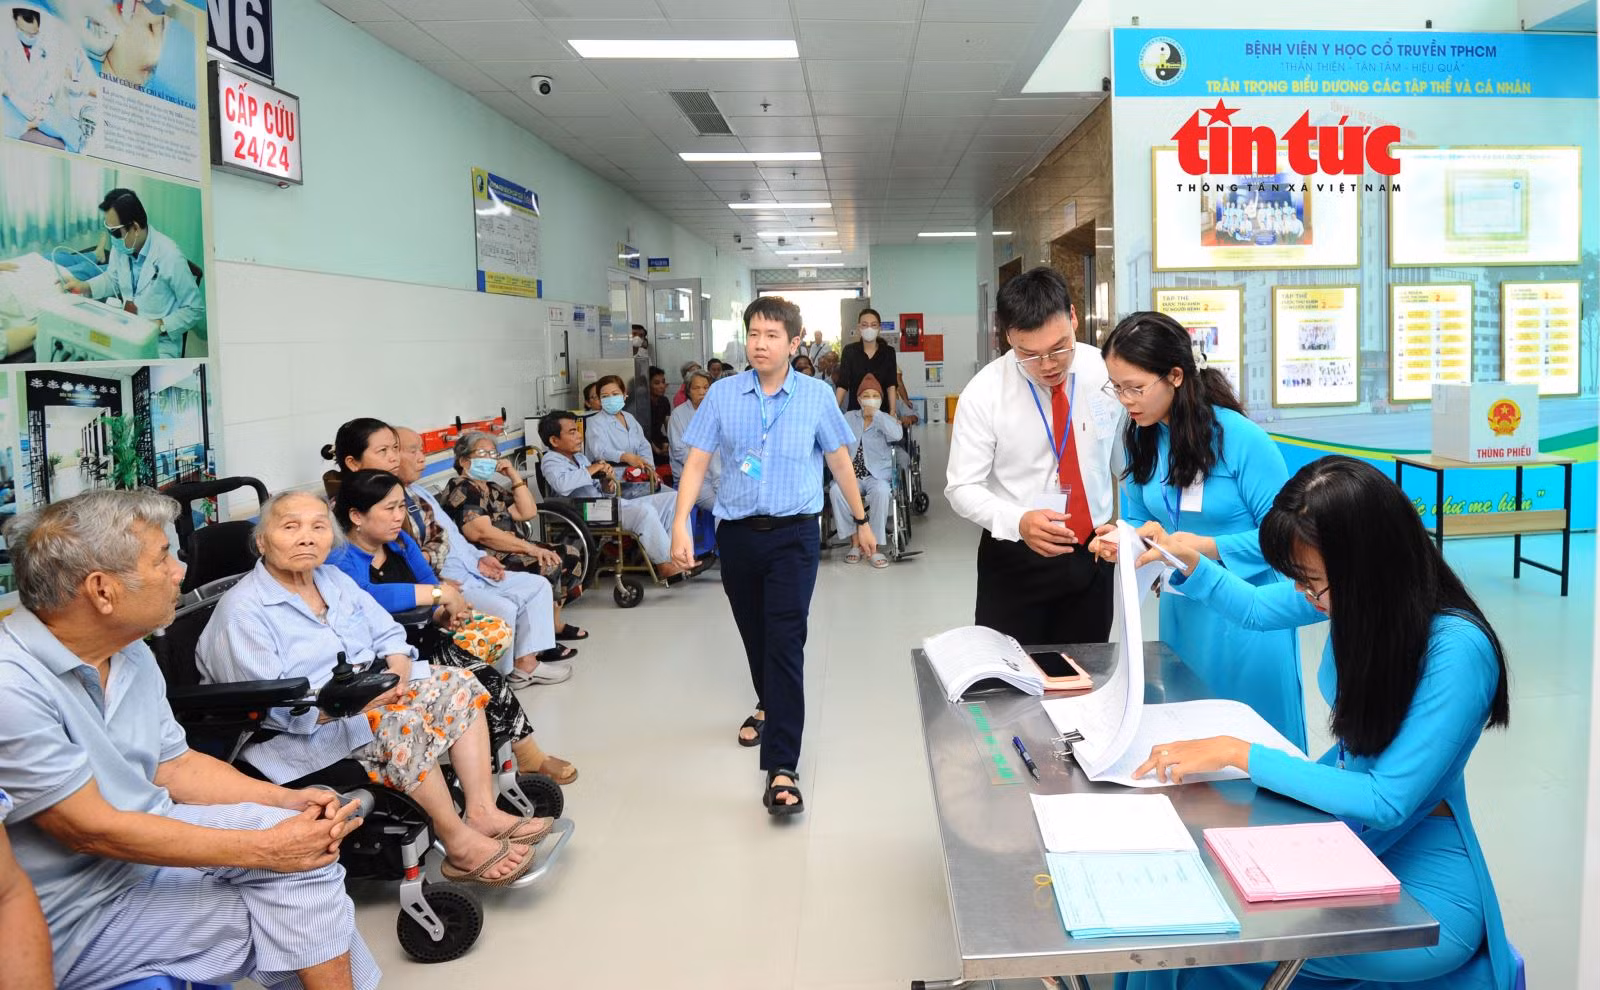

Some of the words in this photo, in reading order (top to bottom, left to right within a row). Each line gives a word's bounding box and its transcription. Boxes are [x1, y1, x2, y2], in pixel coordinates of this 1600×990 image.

[1246, 39, 1282, 59] BỆNH
[1286, 40, 1318, 59] VIỆN
[1322, 43, 1331, 56] Y
[1334, 43, 1367, 59] HỌC
[1371, 38, 1394, 56] CỔ
[1397, 39, 1447, 57] TRUYỀN
[1450, 45, 1497, 57] TPHCM
[1411, 61, 1434, 74] HIỆU
[1206, 75, 1240, 92] TRÂN
[1243, 79, 1289, 96] TRỌNG
[1291, 74, 1318, 93] BIỂU
[1322, 79, 1369, 93] DƯƠNG
[1372, 77, 1401, 93] CÁC
[1404, 78, 1428, 97] TẬP
[1430, 75, 1454, 94] THỂ
[1455, 78, 1472, 94] VÀ
[1475, 79, 1494, 95] CÁ
[1496, 79, 1531, 95] NHÂN
[224, 83, 257, 127] CẤP
[263, 100, 294, 142] CỨU
[234, 131, 289, 172] 24/24
[1477, 446, 1505, 459] THÙNG
[1506, 444, 1532, 457] PHIẾU
